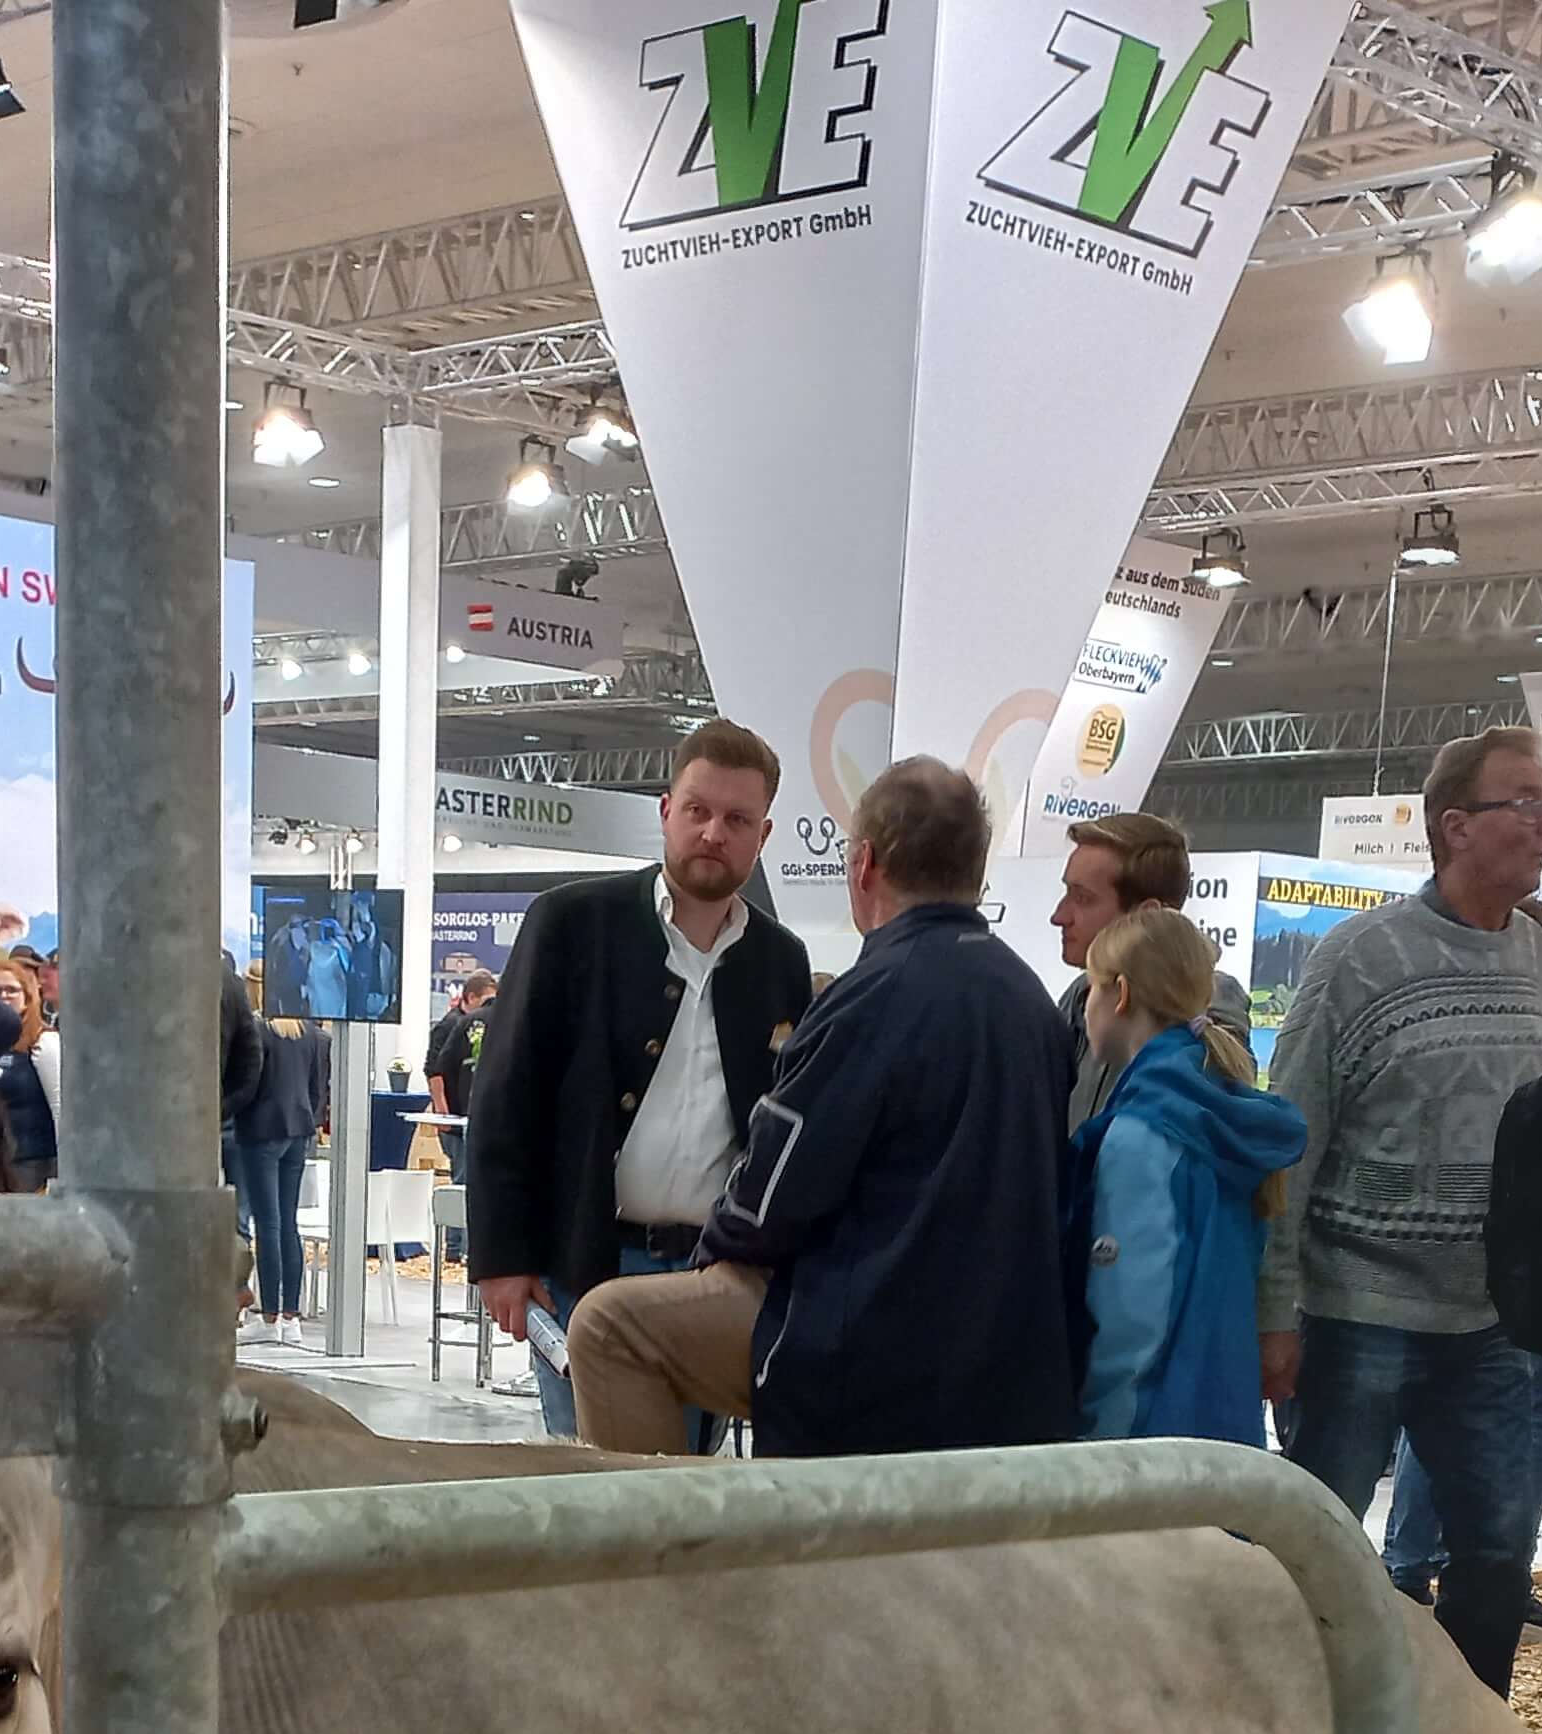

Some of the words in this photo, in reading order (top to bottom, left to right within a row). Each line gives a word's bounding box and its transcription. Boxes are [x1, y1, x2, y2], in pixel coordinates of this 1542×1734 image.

[976, 0, 1272, 260] ZVE
[622, 216, 804, 269] ZUCHTVIEH-EXPORT
[809, 204, 872, 235] GmbH
[965, 200, 1141, 277] ZUCHTVIEH-EXPORT
[1142, 259, 1194, 296] GmbH
[1126, 568, 1148, 585] aus
[1151, 571, 1180, 593] dem
[1105, 590, 1182, 618] eutschlands
[507, 616, 594, 649] AUSTRIA
[1082, 643, 1144, 669] FLECKVIEH
[1078, 661, 1136, 685] Oberbayern
[1089, 718, 1117, 741] BSG
[435, 786, 573, 826] ASTERRIND
[1354, 842, 1384, 855] Milch
[781, 863, 846, 877] GGI-SPERM
[1188, 871, 1228, 899] ion
[1267, 878, 1385, 911] ADAPTABILITY
